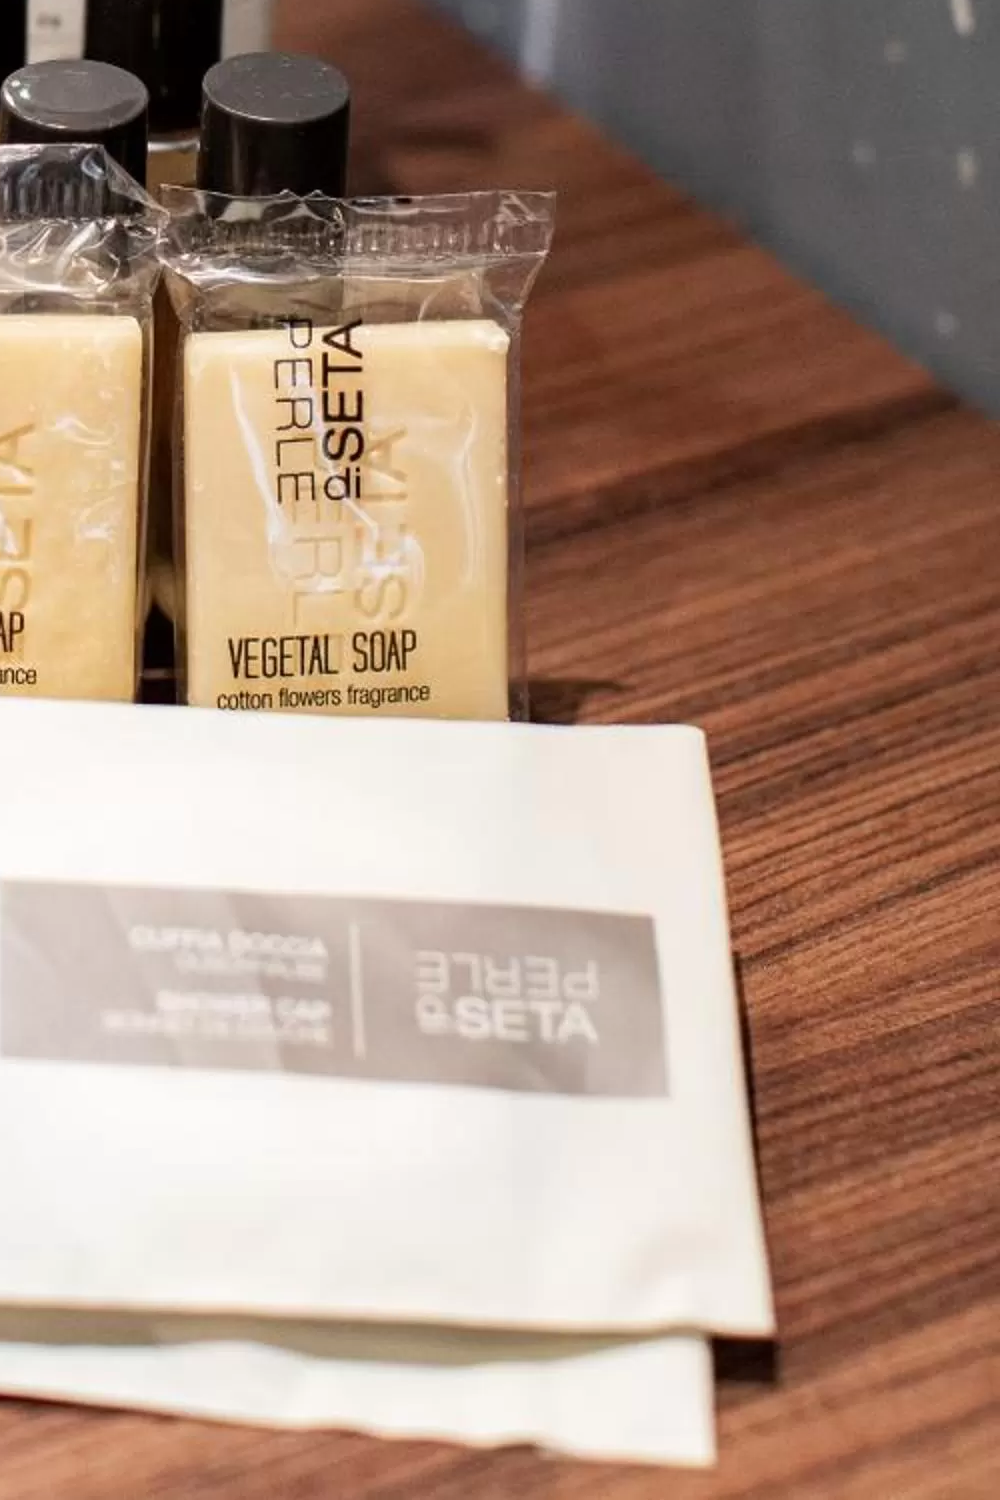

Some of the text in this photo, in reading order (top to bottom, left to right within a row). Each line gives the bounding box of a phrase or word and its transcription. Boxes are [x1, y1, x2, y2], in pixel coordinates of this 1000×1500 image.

[274, 318, 315, 504] PERLE
[322, 318, 365, 463] SETA
[228, 629, 417, 679] VEGETAL SOAP
[217, 684, 430, 711] cotton flowers fragrance
[414, 948, 600, 1001] PERLE
[455, 995, 600, 1045] SETA
